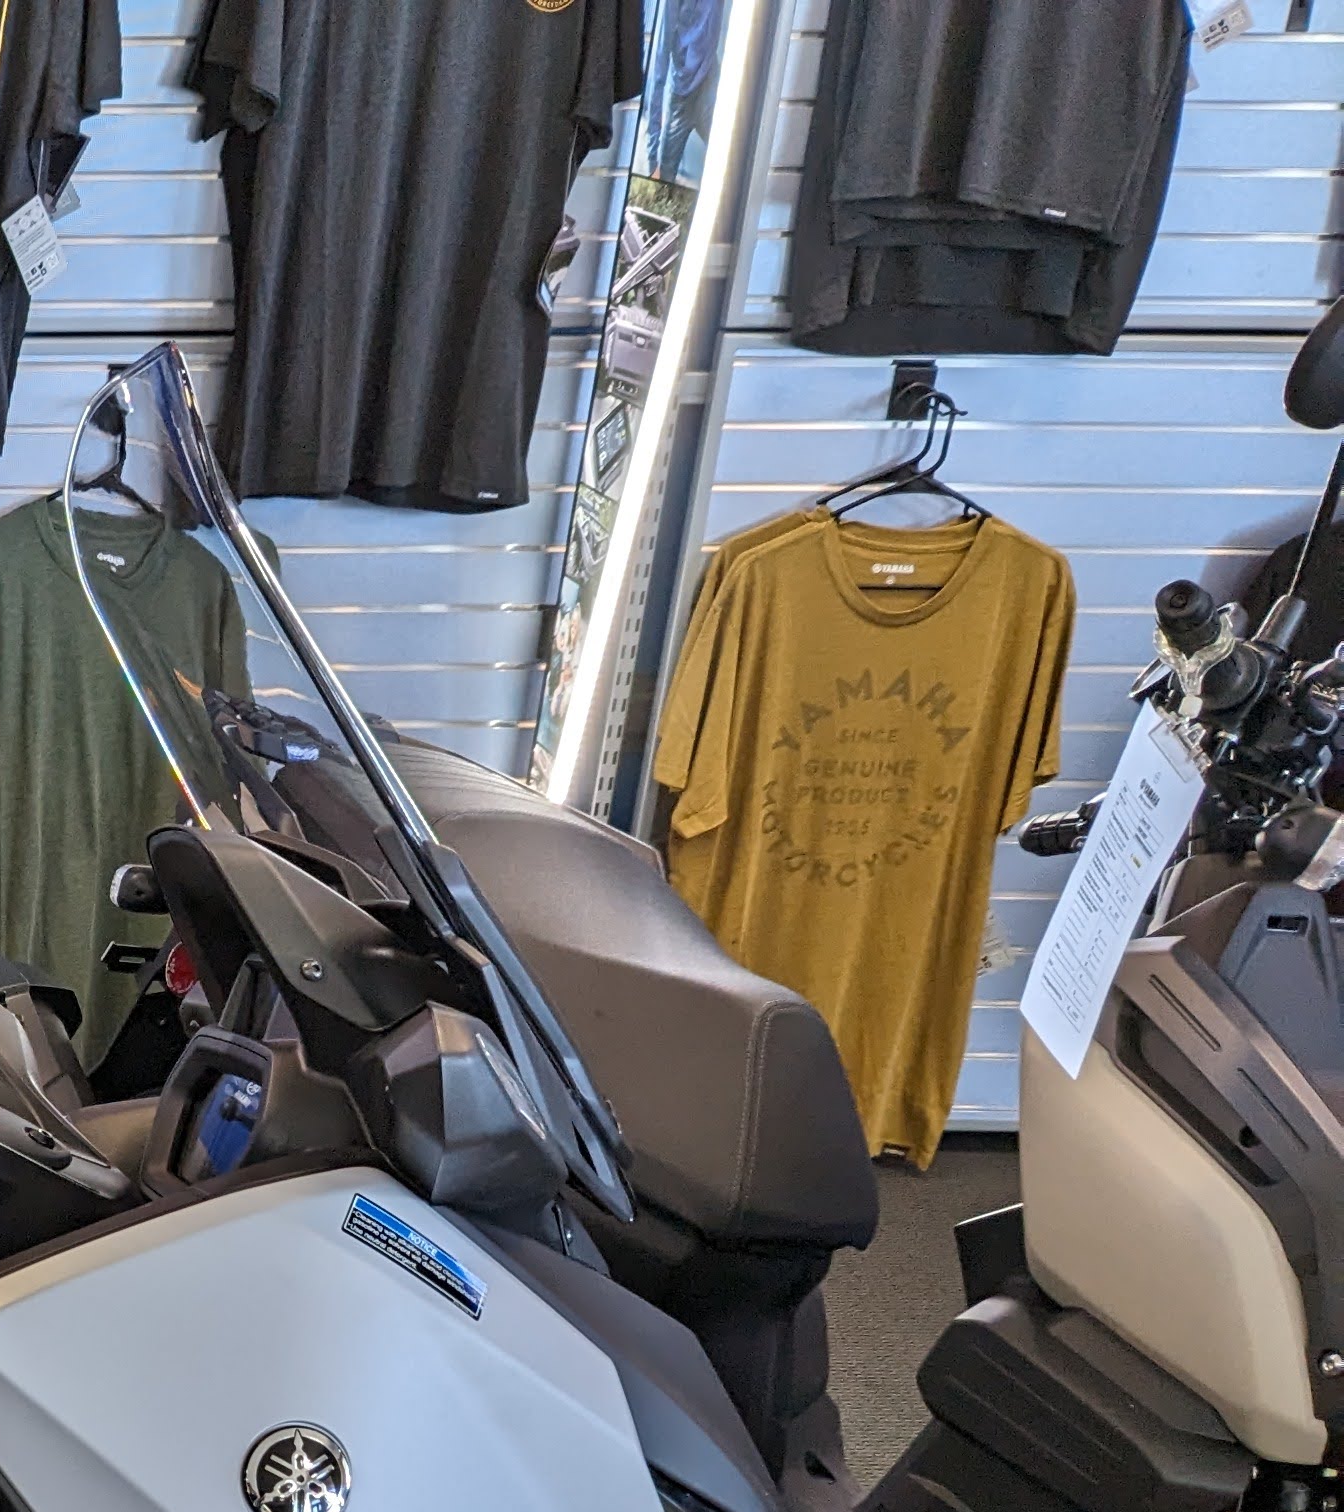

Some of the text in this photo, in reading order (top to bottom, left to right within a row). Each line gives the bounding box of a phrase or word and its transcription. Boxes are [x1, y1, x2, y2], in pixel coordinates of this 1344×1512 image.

[772, 668, 972, 753] YAMAHA
[838, 728, 899, 744] SINCE
[804, 759, 919, 777] GENUINE
[795, 786, 910, 804] PRODUCT
[350, 1223, 363, 1235] Use
[364, 1231, 387, 1250] neutral
[354, 1211, 384, 1232] Cleaning
[384, 1227, 398, 1241] with
[352, 1217, 379, 1236] gasoline
[380, 1232, 388, 1241] or
[388, 1237, 411, 1256] solvent
[422, 1260, 447, 1281] damage
[408, 1232, 438, 1257] NOTICE
